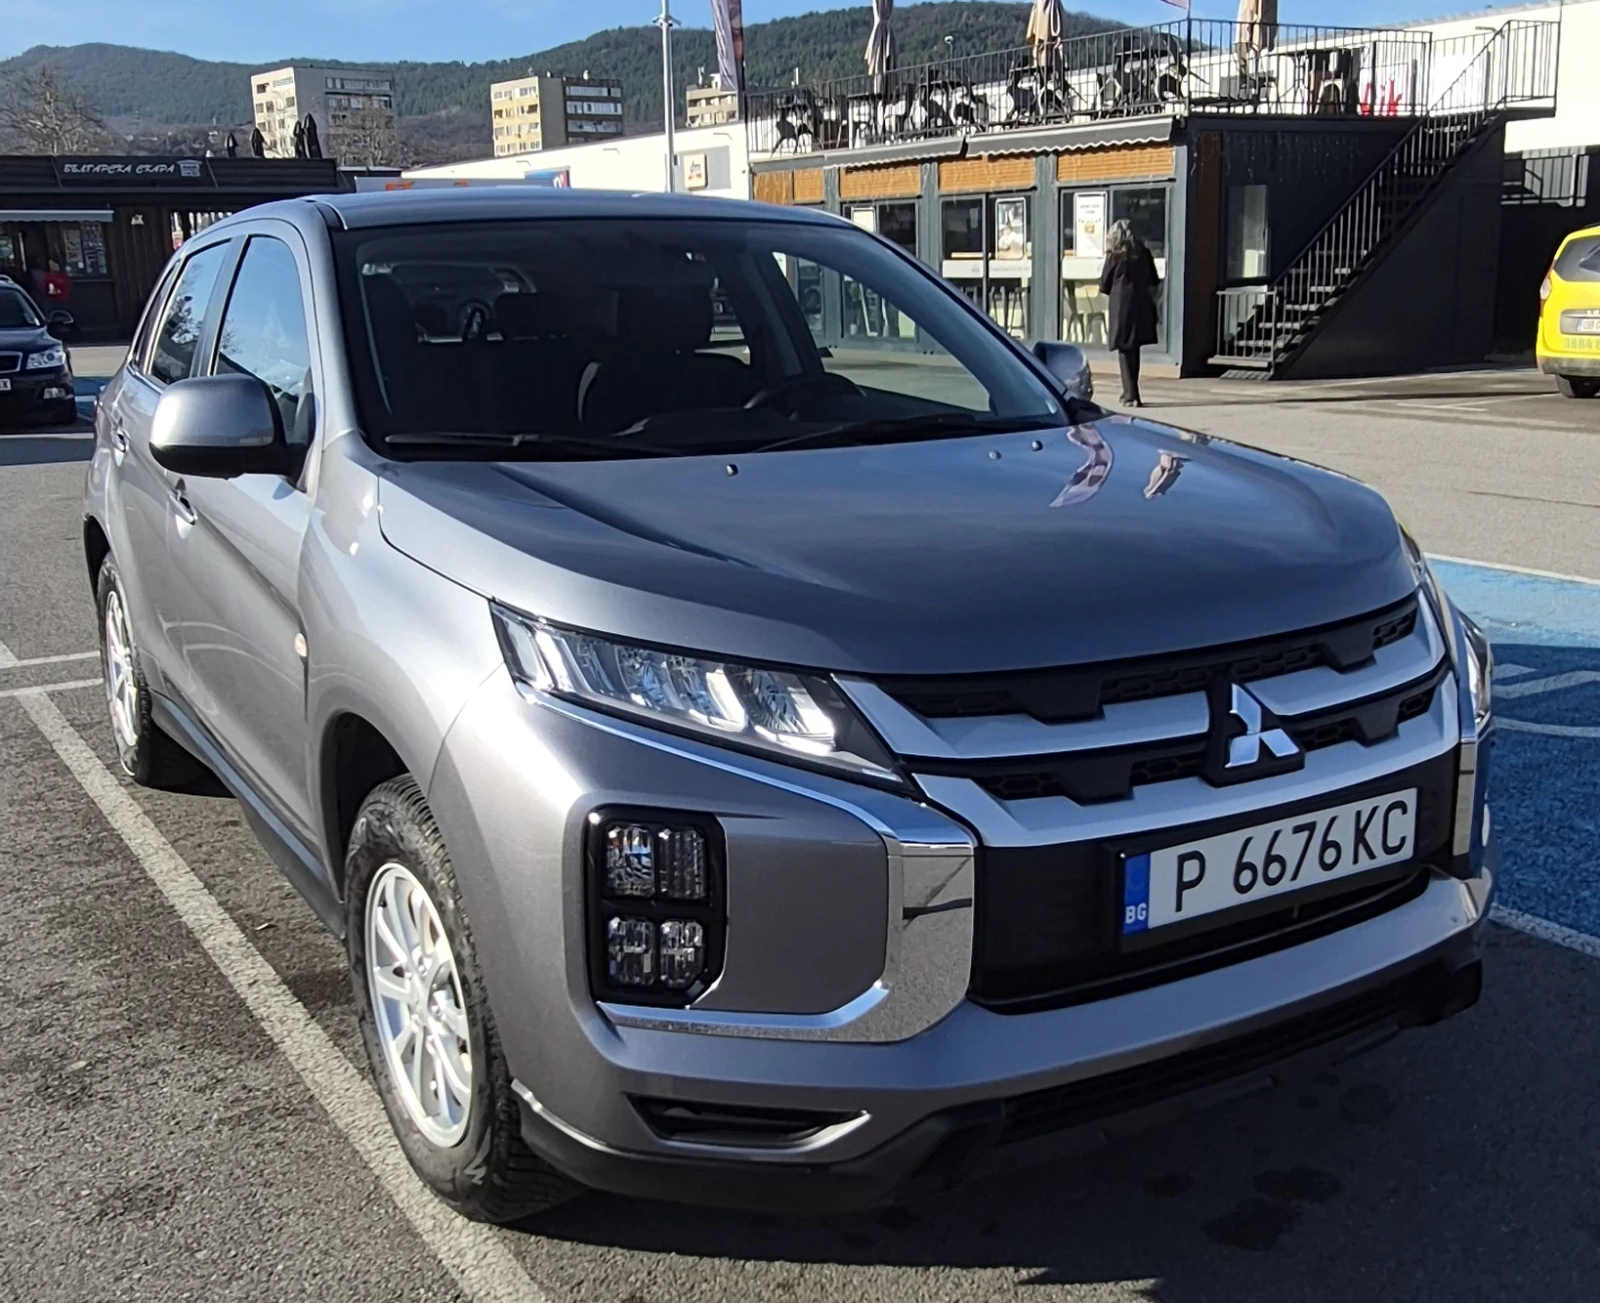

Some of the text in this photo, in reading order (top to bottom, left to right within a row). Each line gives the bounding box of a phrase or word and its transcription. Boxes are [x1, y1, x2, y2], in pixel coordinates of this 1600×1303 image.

[135, 164, 175, 174] СКАРА
[1175, 850, 1206, 913] P
[1125, 902, 1147, 924] BG
